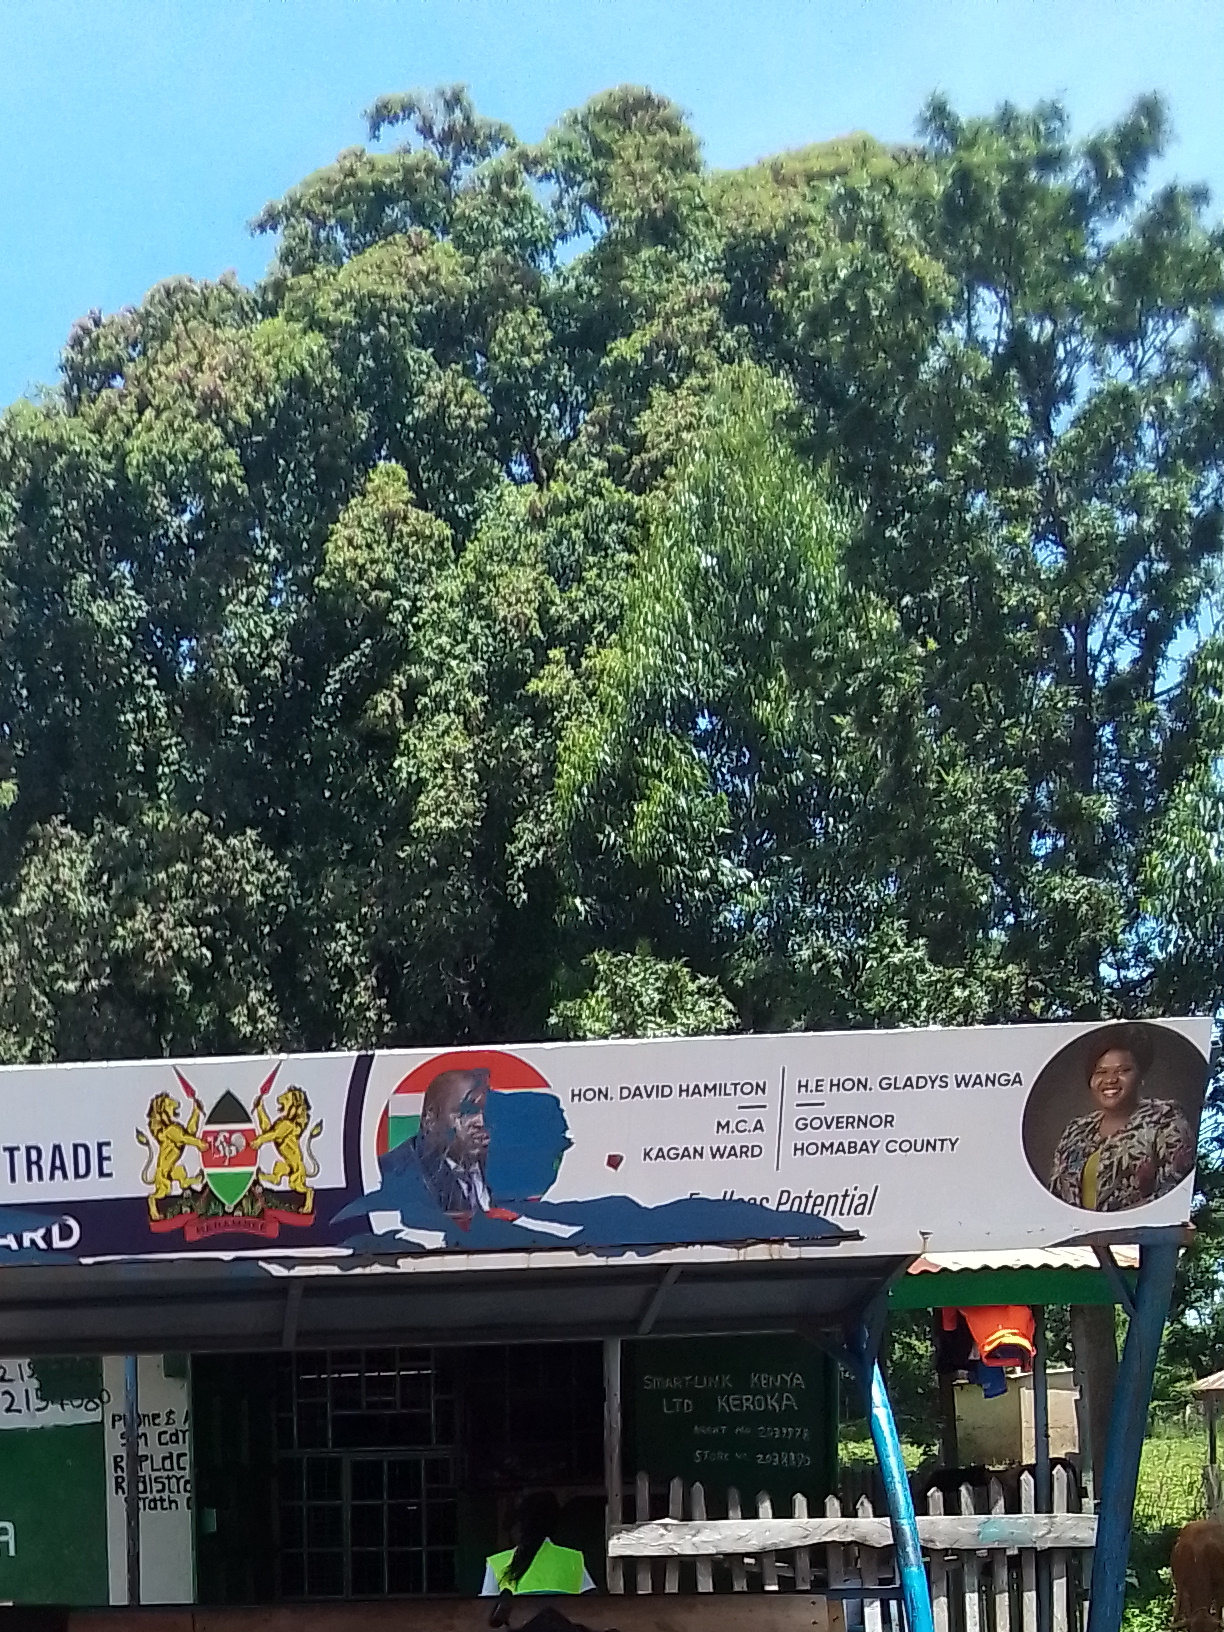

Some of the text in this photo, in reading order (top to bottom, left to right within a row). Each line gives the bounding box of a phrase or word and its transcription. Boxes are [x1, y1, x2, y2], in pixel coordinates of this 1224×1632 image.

[570, 1080, 767, 1103] HON. DAVID HAMILTON
[797, 1072, 1024, 1094] H.E HON. GLADYS WANGA
[716, 1118, 765, 1135] M.C.A
[794, 1114, 895, 1132] GOVERNOR
[642, 1144, 763, 1162] KAGAN WARD
[793, 1137, 960, 1157] HOMABAY COUNTY
[2, 1139, 114, 1185] TRADE
[777, 1184, 880, 1217] Potential
[749, 1372, 806, 1389] KENYA
[663, 1392, 799, 1414] LTD KEROKA
